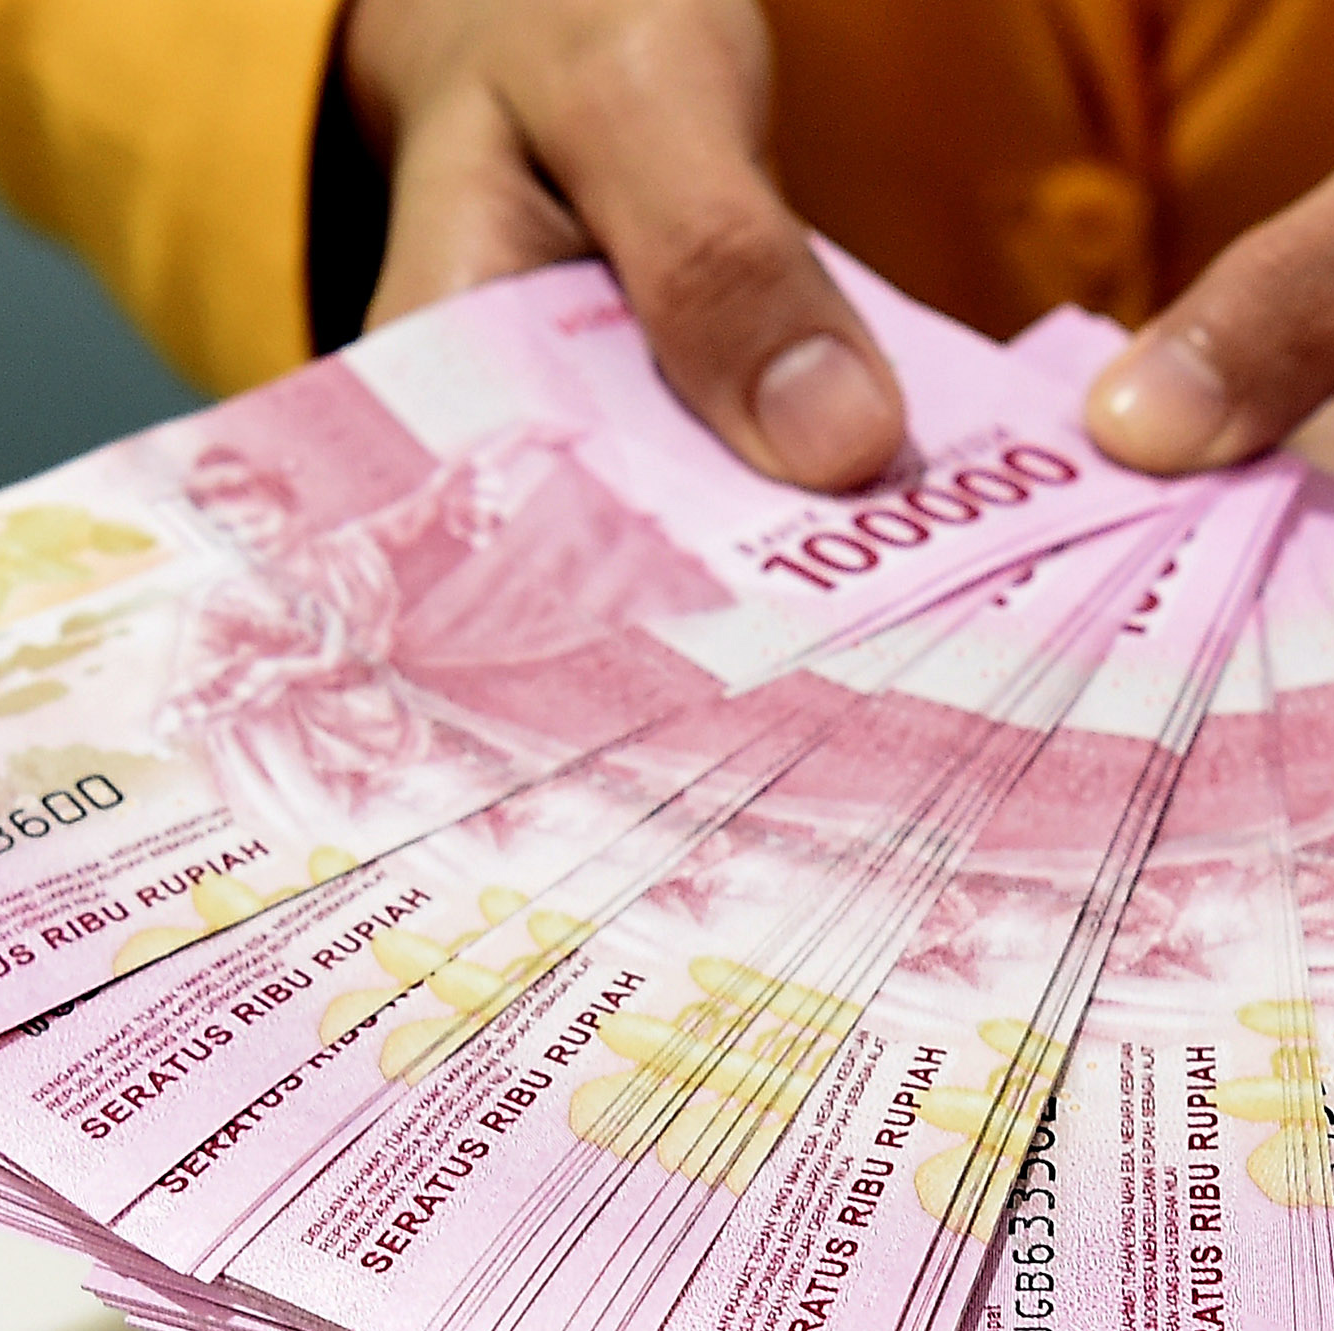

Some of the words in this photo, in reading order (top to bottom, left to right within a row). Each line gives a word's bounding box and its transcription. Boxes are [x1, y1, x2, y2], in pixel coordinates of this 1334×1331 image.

[761, 447, 1080, 592] 100000
[39, 900, 130, 950] RIBU
[135, 839, 269, 908] RUPIAH
[80, 1024, 233, 1139] SERATUS
[229, 968, 313, 1026] RIBU
[310, 887, 431, 970] RUPIAH
[359, 1137, 490, 1274] SERATUS
[476, 1068, 553, 1134] RIBU
[542, 970, 645, 1066] RUPIAH
[835, 1157, 894, 1228] RIBU
[873, 1045, 947, 1149] RUPIAH
[1185, 1045, 1219, 1151] RUPIAH
[1187, 1163, 1222, 1232] RIBU
